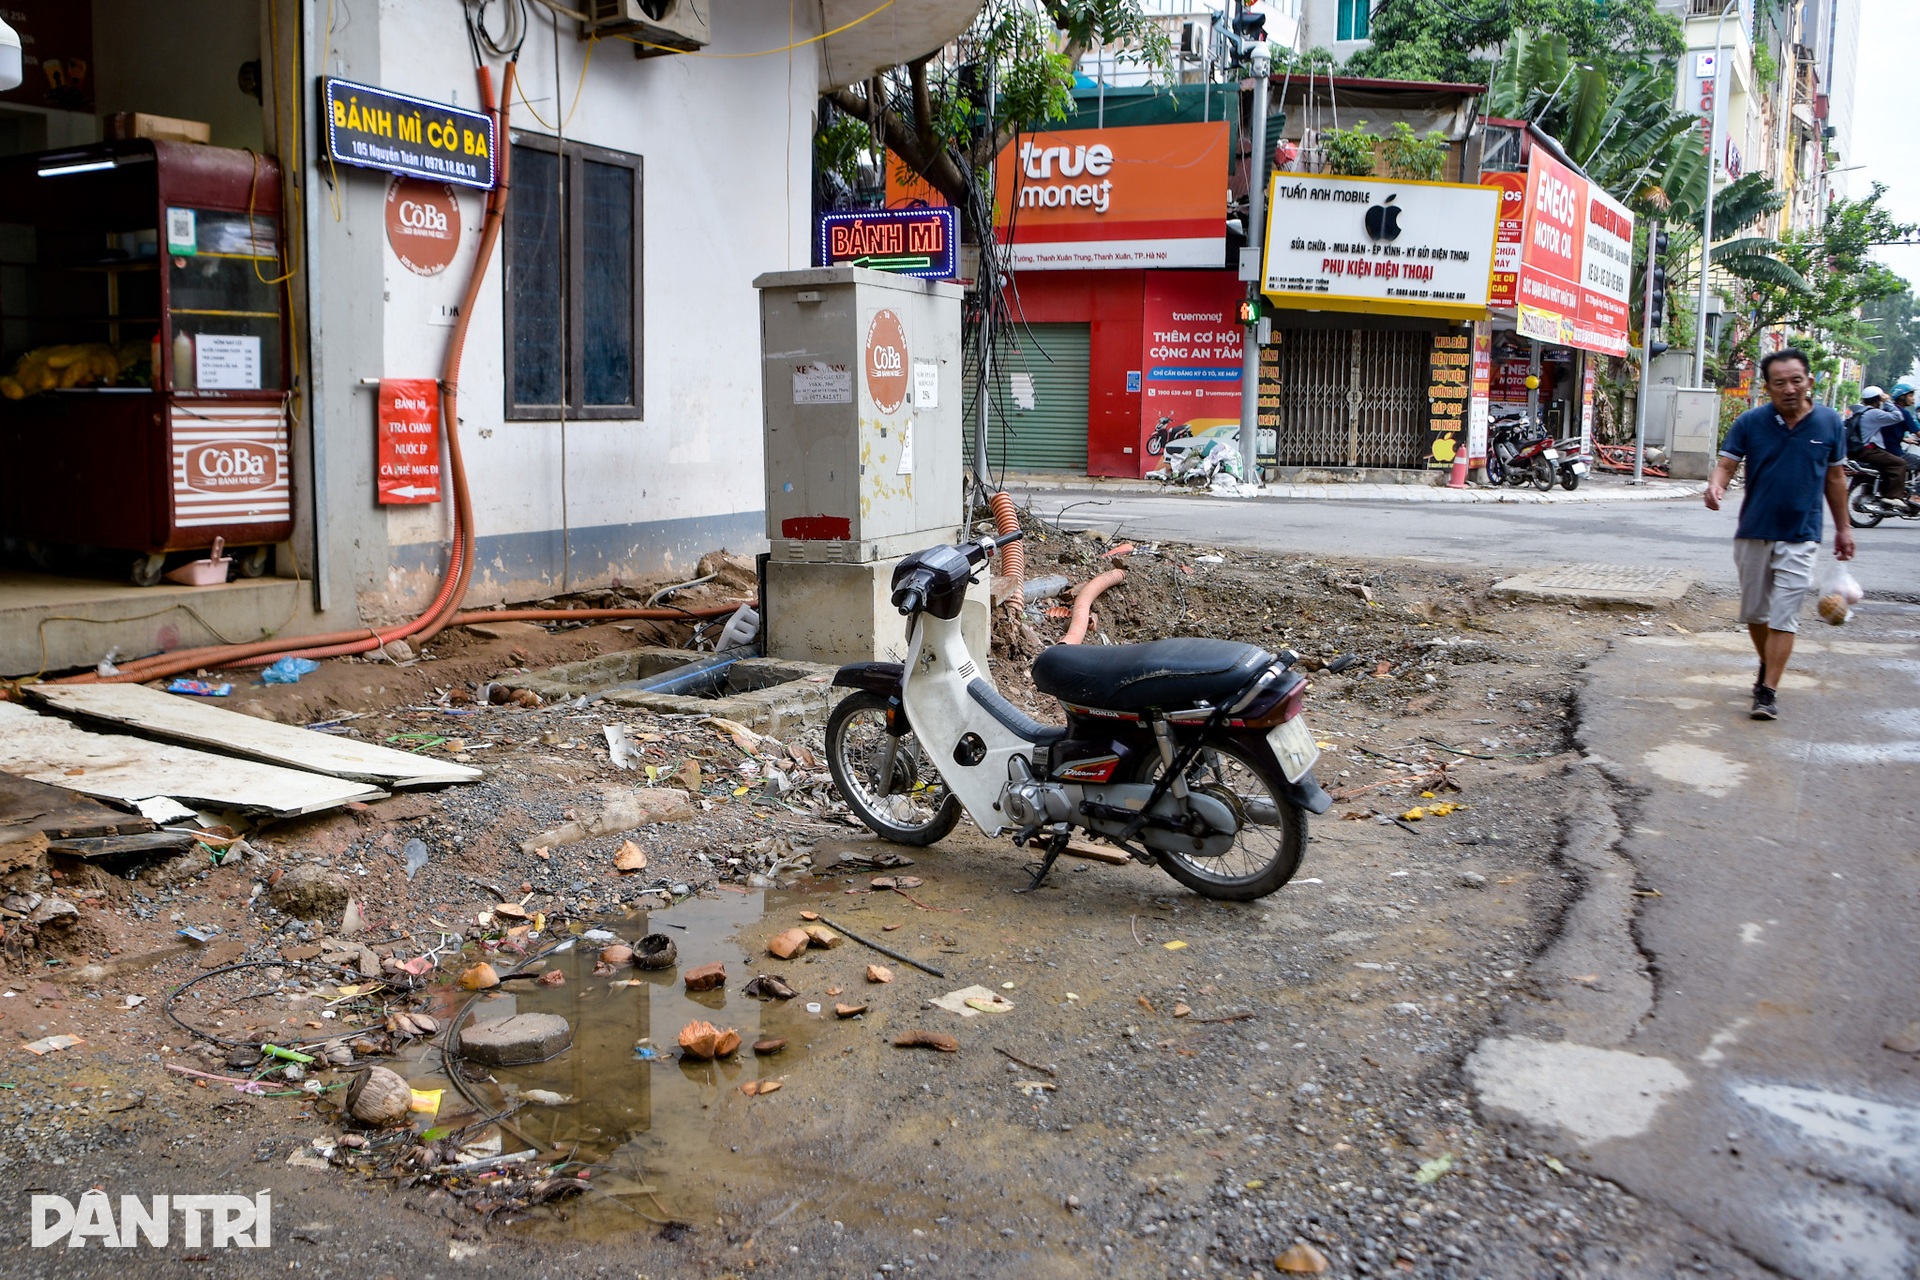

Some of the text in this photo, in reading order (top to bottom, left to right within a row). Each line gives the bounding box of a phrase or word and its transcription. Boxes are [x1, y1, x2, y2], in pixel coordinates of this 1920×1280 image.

[333, 96, 488, 158] BÁNH MÌ CÔ BA
[352, 141, 368, 156] 105
[369, 144, 399, 162] Nguyễn
[424, 156, 476, 178] 0978.18.83.18
[1020, 142, 1113, 179] true
[1019, 179, 1113, 213] money
[1333, 190, 1370, 203] MOBILE
[1502, 191, 1522, 201] EOS
[1537, 170, 1576, 228] ENEOS
[399, 200, 447, 231] CôBa
[832, 216, 943, 255] BÁNH MÌ
[1534, 220, 1572, 259] MOTOR OIL
[1333, 243, 1349, 253] MUA
[1351, 243, 1366, 254] BÁN
[1450, 250, 1470, 262] THOẠI
[1322, 258, 1434, 283] PHỤ KIỆN ĐIỆN THOẠI
[1172, 312, 1222, 323] truemoney
[1153, 330, 1240, 346] THÊM CƠ HỘI
[1434, 335, 1467, 348] MUA BÁN
[874, 345, 901, 369] CôBa
[1150, 345, 1243, 361] CỘNG AN TÂM
[409, 422, 431, 433] CHANH
[199, 448, 265, 477] CôBa
[1089, 709, 1119, 718] HONDA
